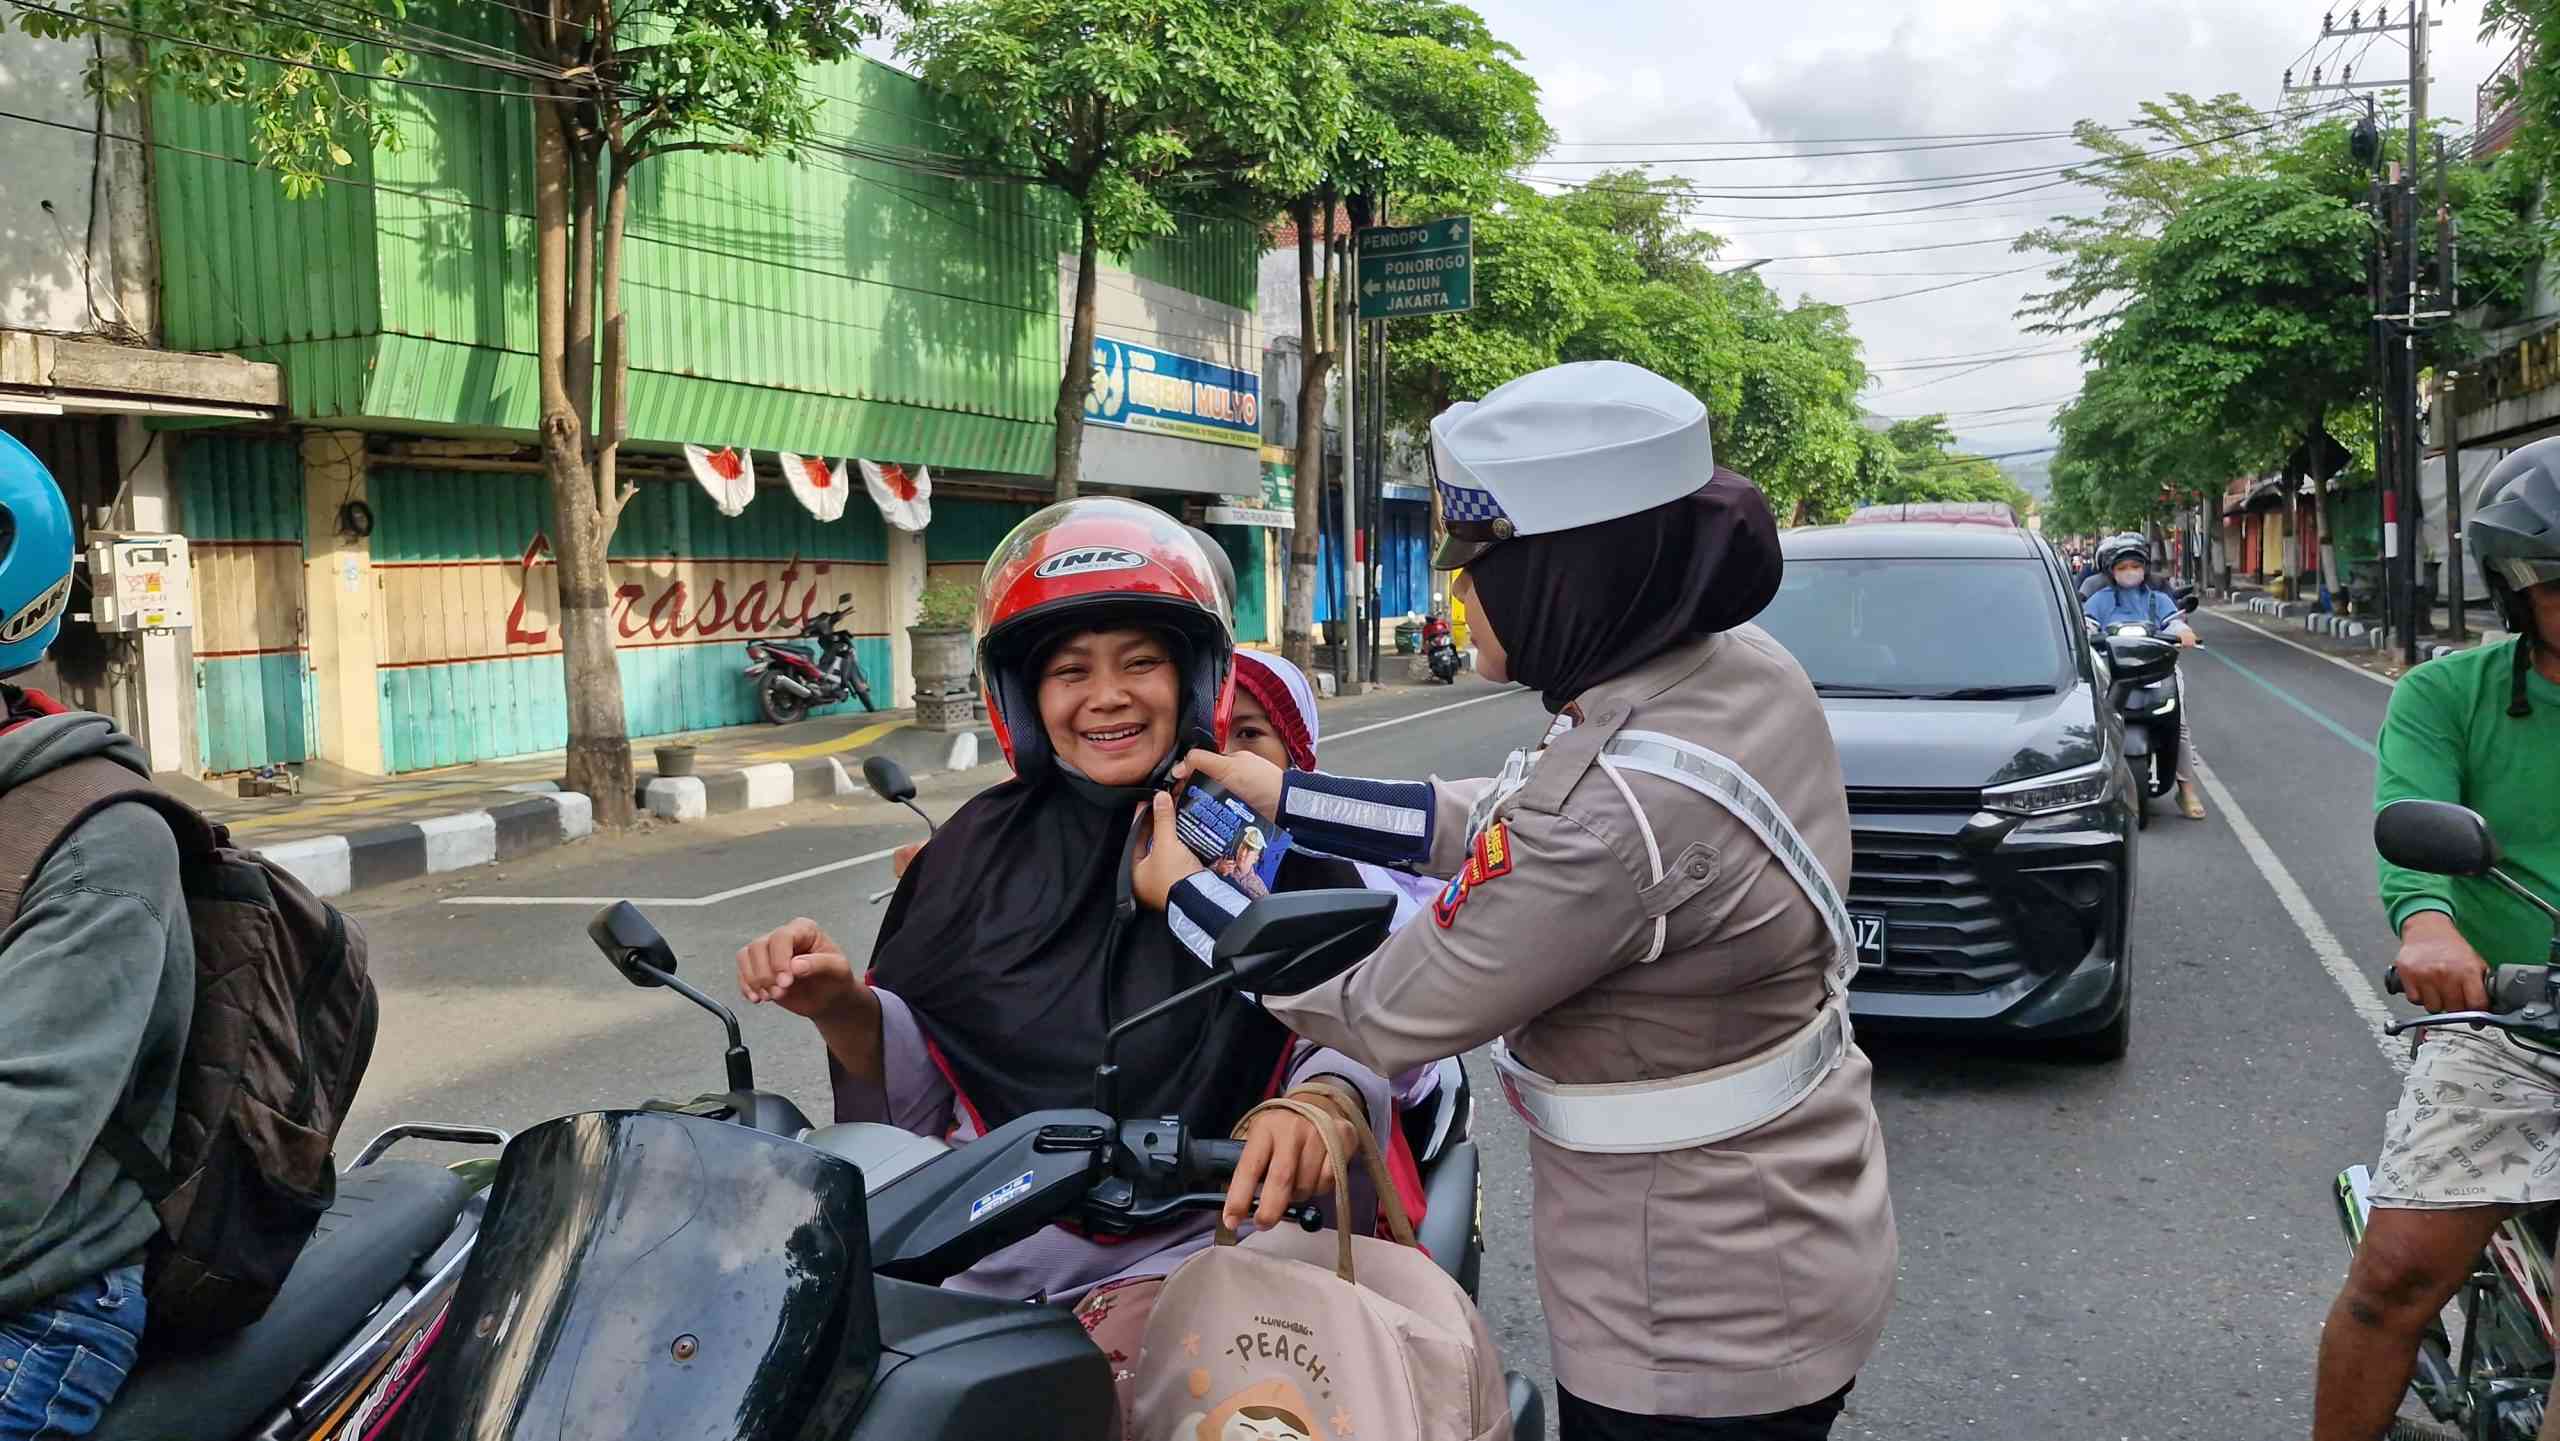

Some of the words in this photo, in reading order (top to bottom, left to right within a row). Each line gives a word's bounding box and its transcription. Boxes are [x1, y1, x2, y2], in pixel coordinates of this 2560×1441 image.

[1363, 229, 1429, 249] PENDOPO
[1385, 254, 1466, 275] PONOROGO
[1385, 275, 1441, 294] MADIUN
[1386, 291, 1449, 311] JAKARTA
[1195, 381, 1257, 426] MULYO
[1046, 552, 1132, 573] INK
[506, 531, 832, 646] Lrasati
[11, 582, 66, 637] INK
